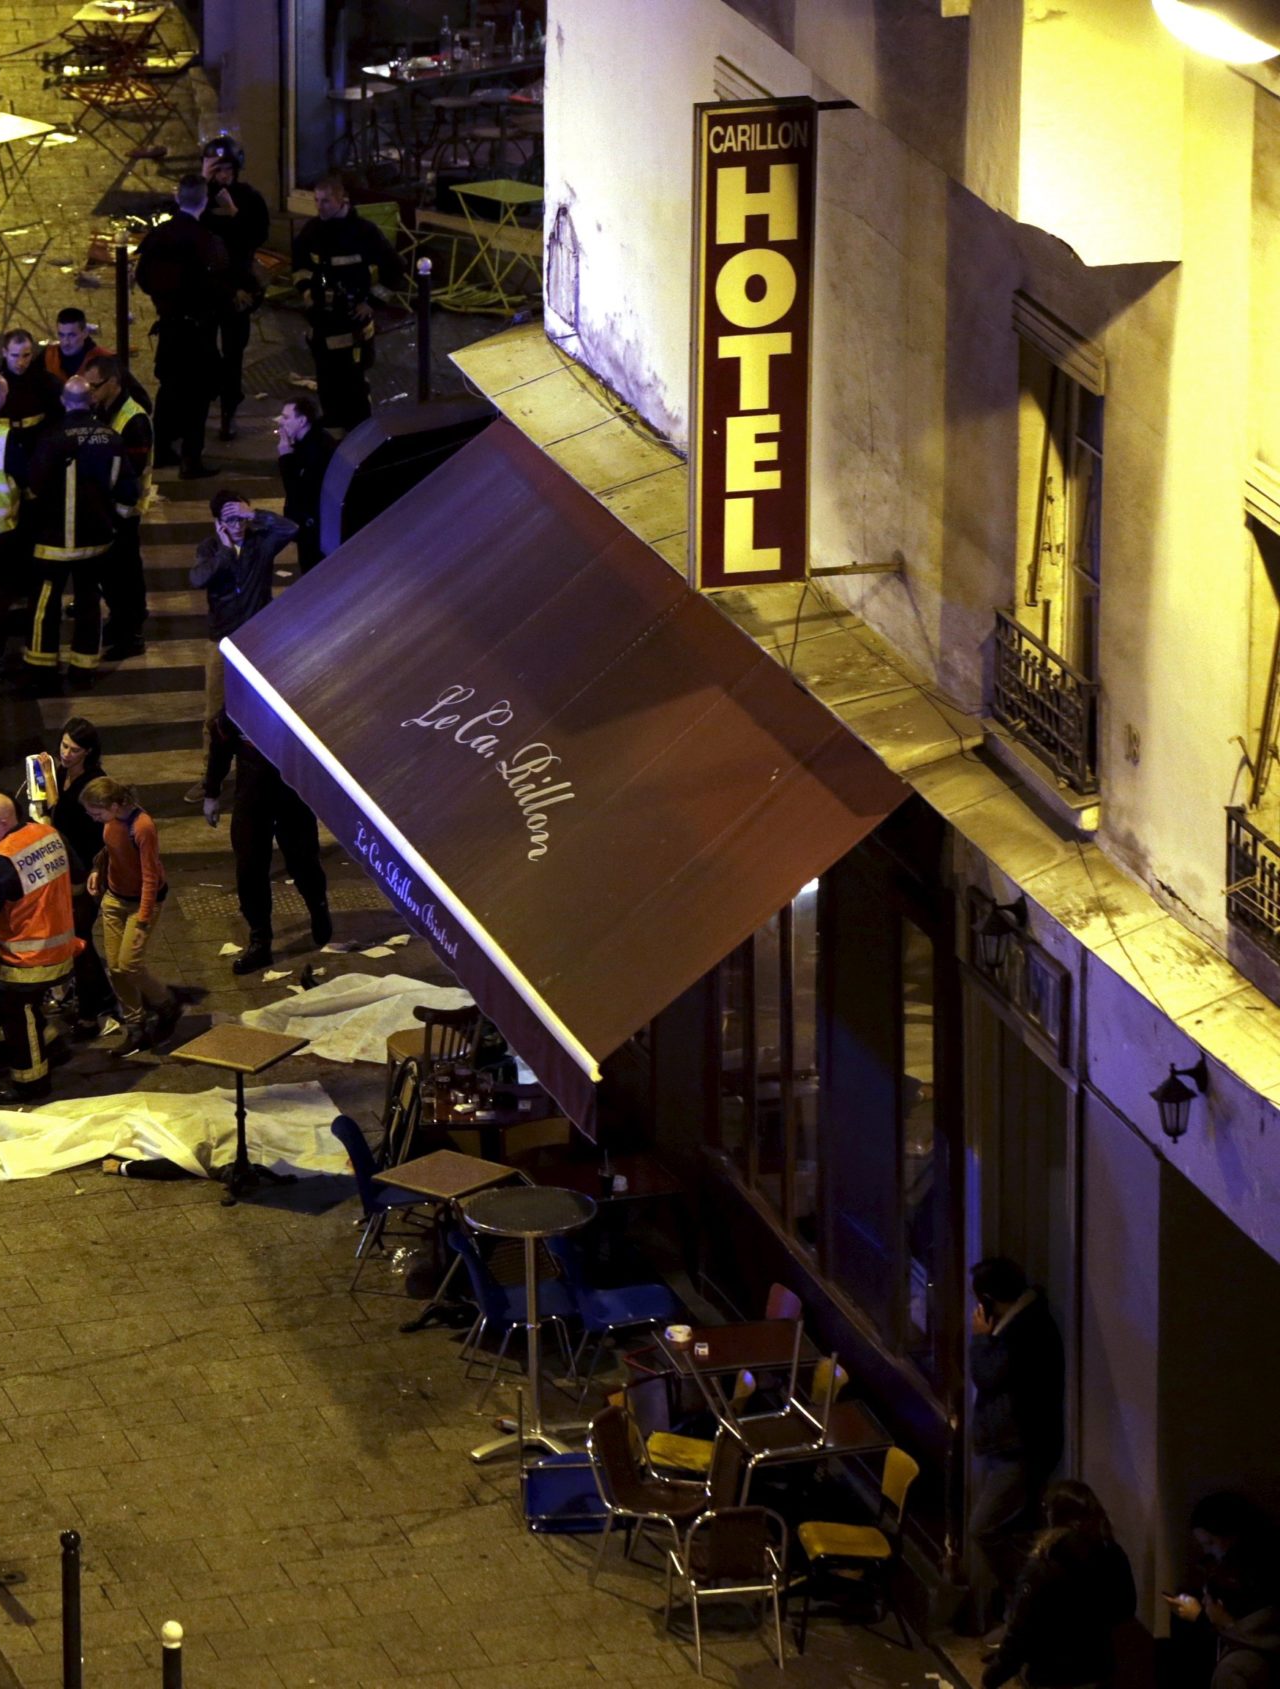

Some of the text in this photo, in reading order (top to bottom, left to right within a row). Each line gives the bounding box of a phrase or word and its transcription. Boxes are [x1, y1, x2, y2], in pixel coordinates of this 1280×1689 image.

[708, 121, 809, 154] CARILLON
[715, 163, 799, 574] HOTEL
[400, 684, 475, 730] Le
[17, 839, 63, 870] POMPIERS
[27, 868, 45, 884] DE
